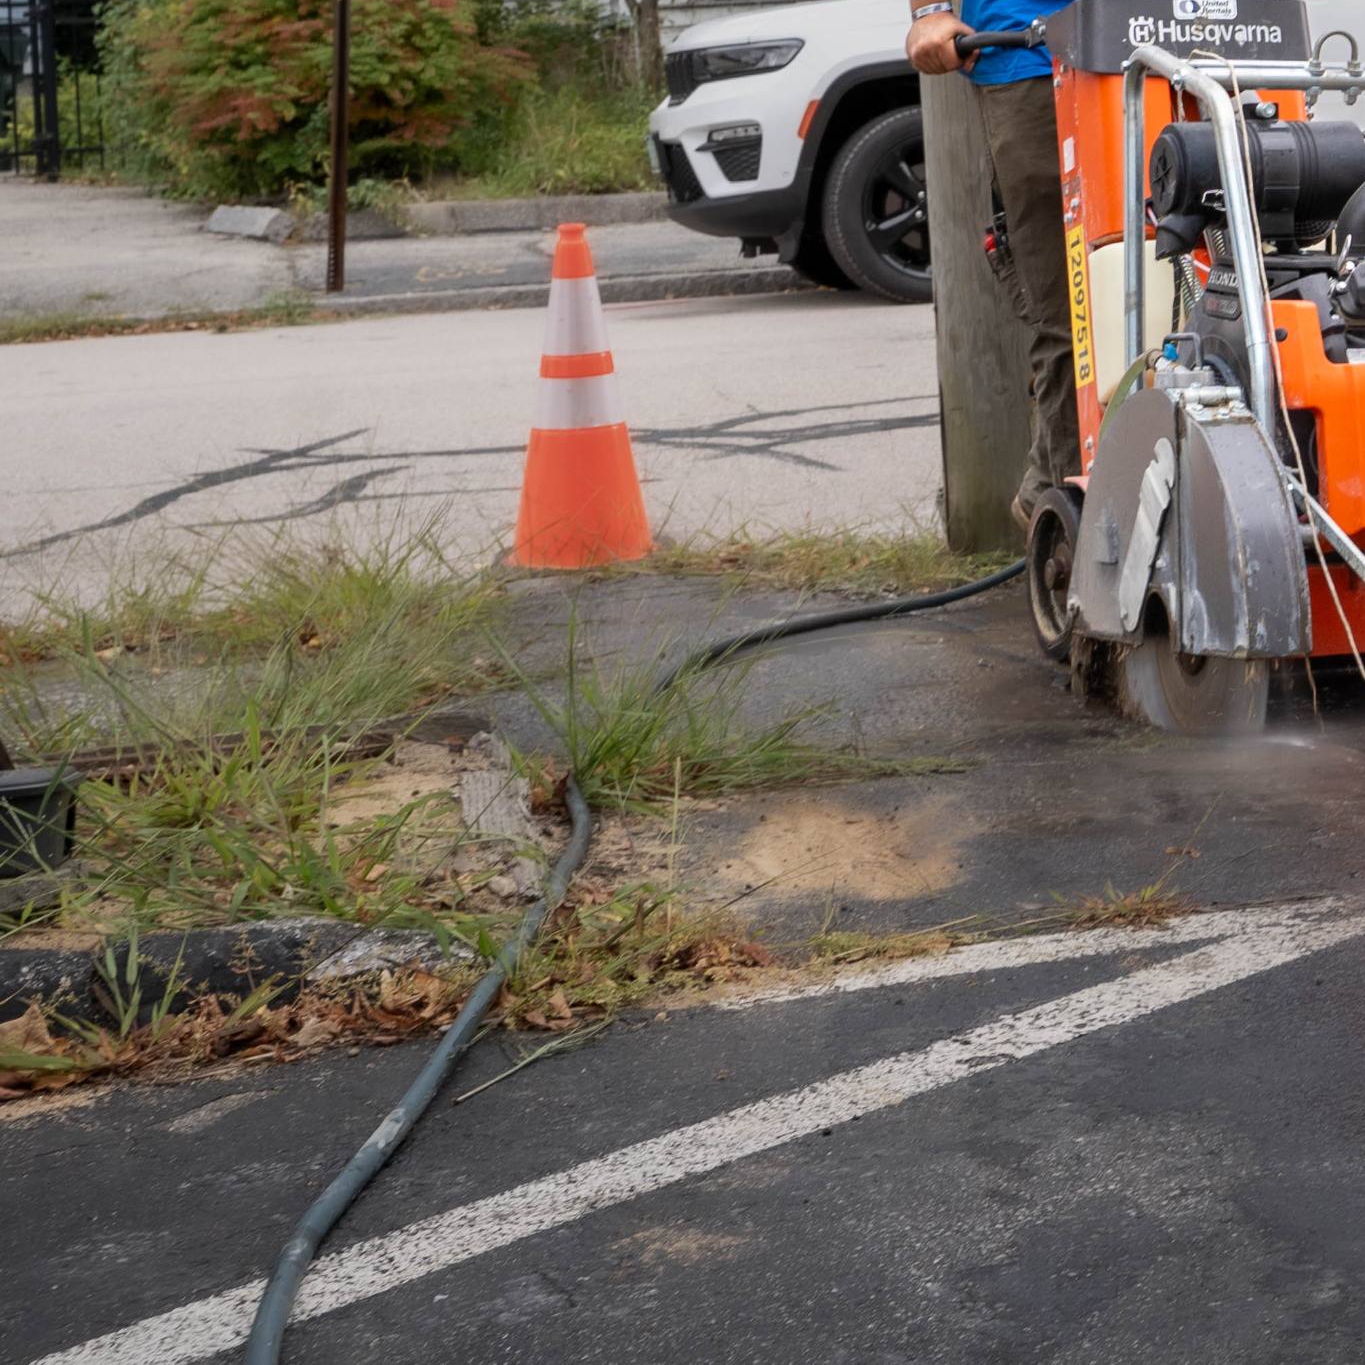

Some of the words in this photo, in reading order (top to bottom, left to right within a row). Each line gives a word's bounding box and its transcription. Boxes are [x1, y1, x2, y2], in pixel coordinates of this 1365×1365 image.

[1158, 20, 1282, 46] Husqvarna
[1208, 269, 1240, 288] HOND
[1070, 234, 1091, 381] 12097518
